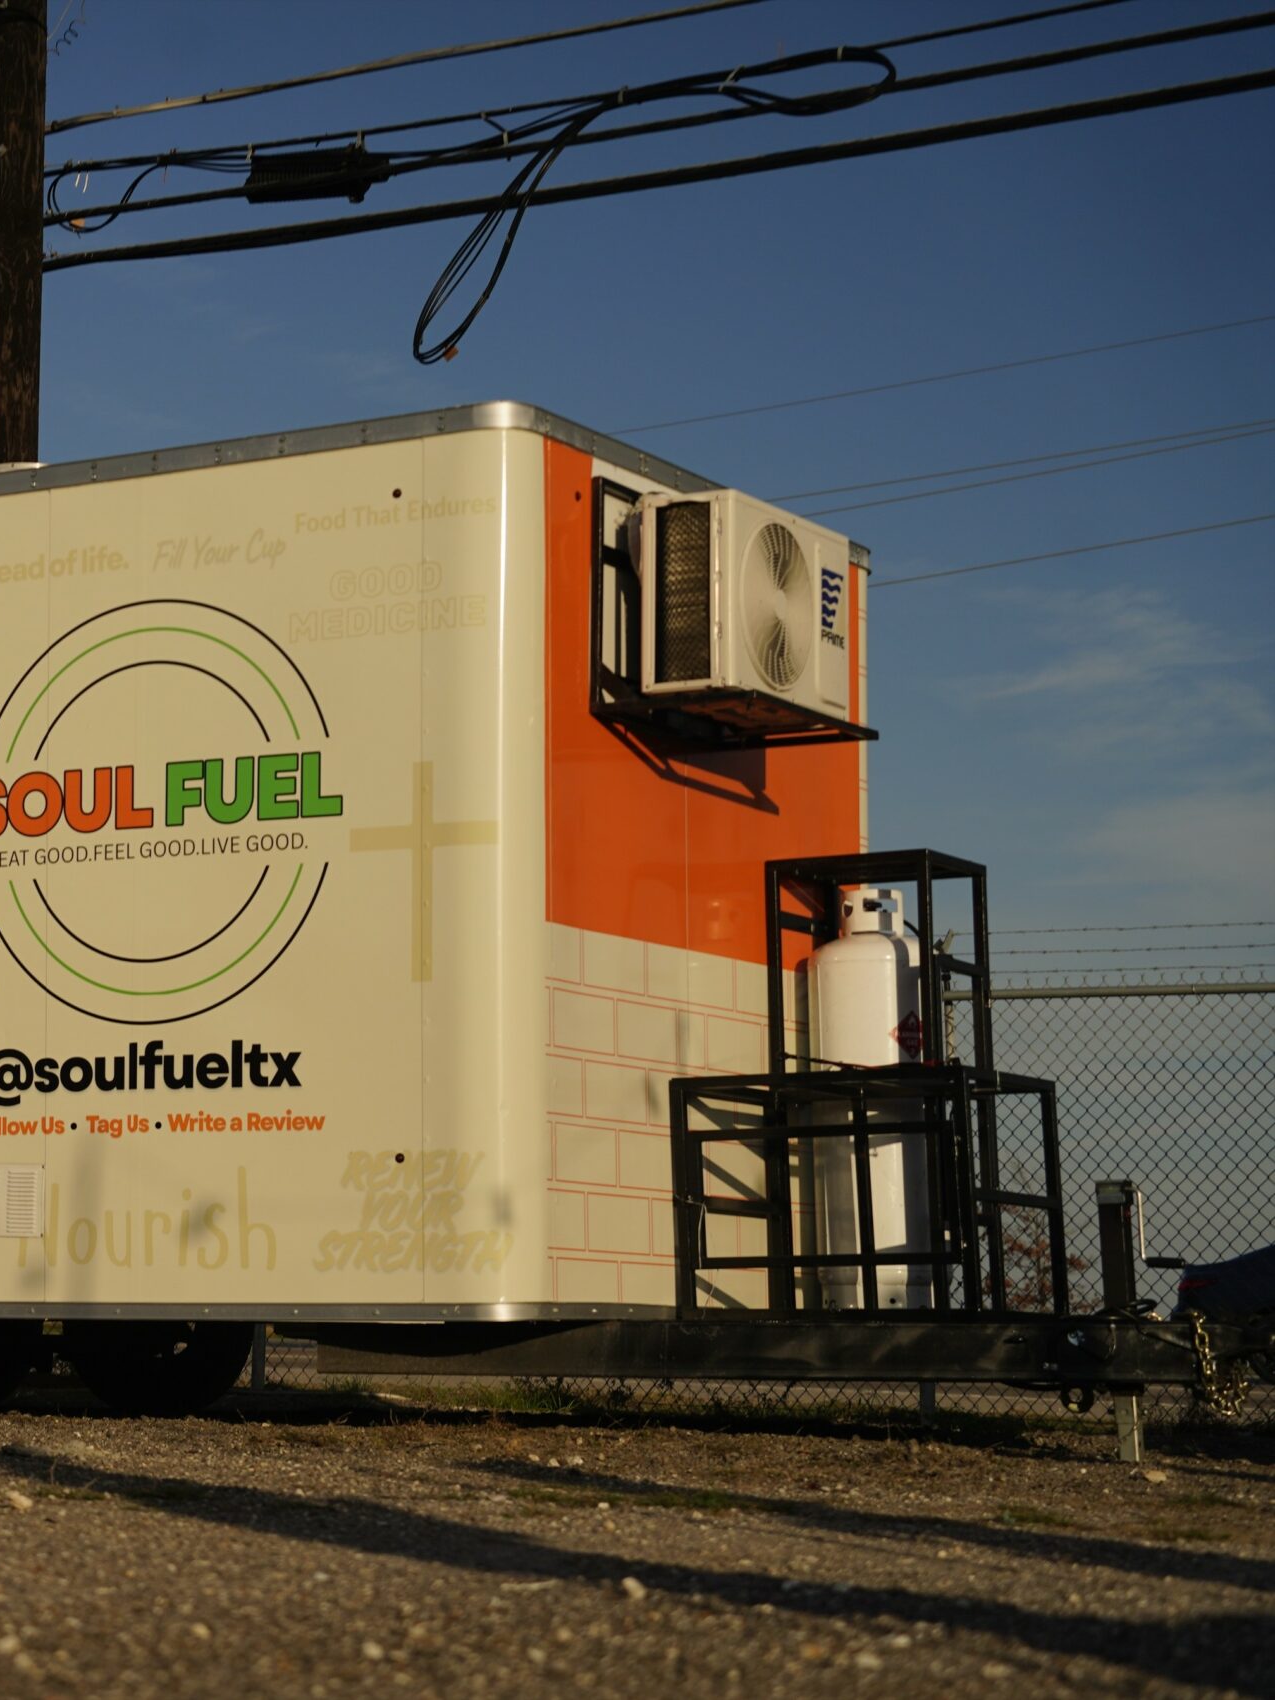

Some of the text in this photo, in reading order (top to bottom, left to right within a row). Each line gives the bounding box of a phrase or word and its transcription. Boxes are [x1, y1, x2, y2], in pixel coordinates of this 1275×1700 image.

[293, 496, 497, 535] Food That Endures
[47, 550, 78, 578] of
[80, 544, 130, 576] life.
[152, 527, 287, 573] Fill Your Cup
[329, 560, 443, 600] GOOD
[288, 595, 486, 644] MEDICINE
[165, 751, 343, 827] FUEL
[246, 831, 309, 852] GOOD.
[41, 1115, 65, 1135] Us
[85, 1114, 123, 1139] Tag
[127, 1113, 150, 1134] Us
[167, 1109, 226, 1133] Write
[229, 1115, 243, 1133] a
[246, 1108, 326, 1133] Review
[339, 1149, 485, 1192] RENEW
[358, 1189, 465, 1233] YOUR
[312, 1229, 515, 1275] STRENGTH
